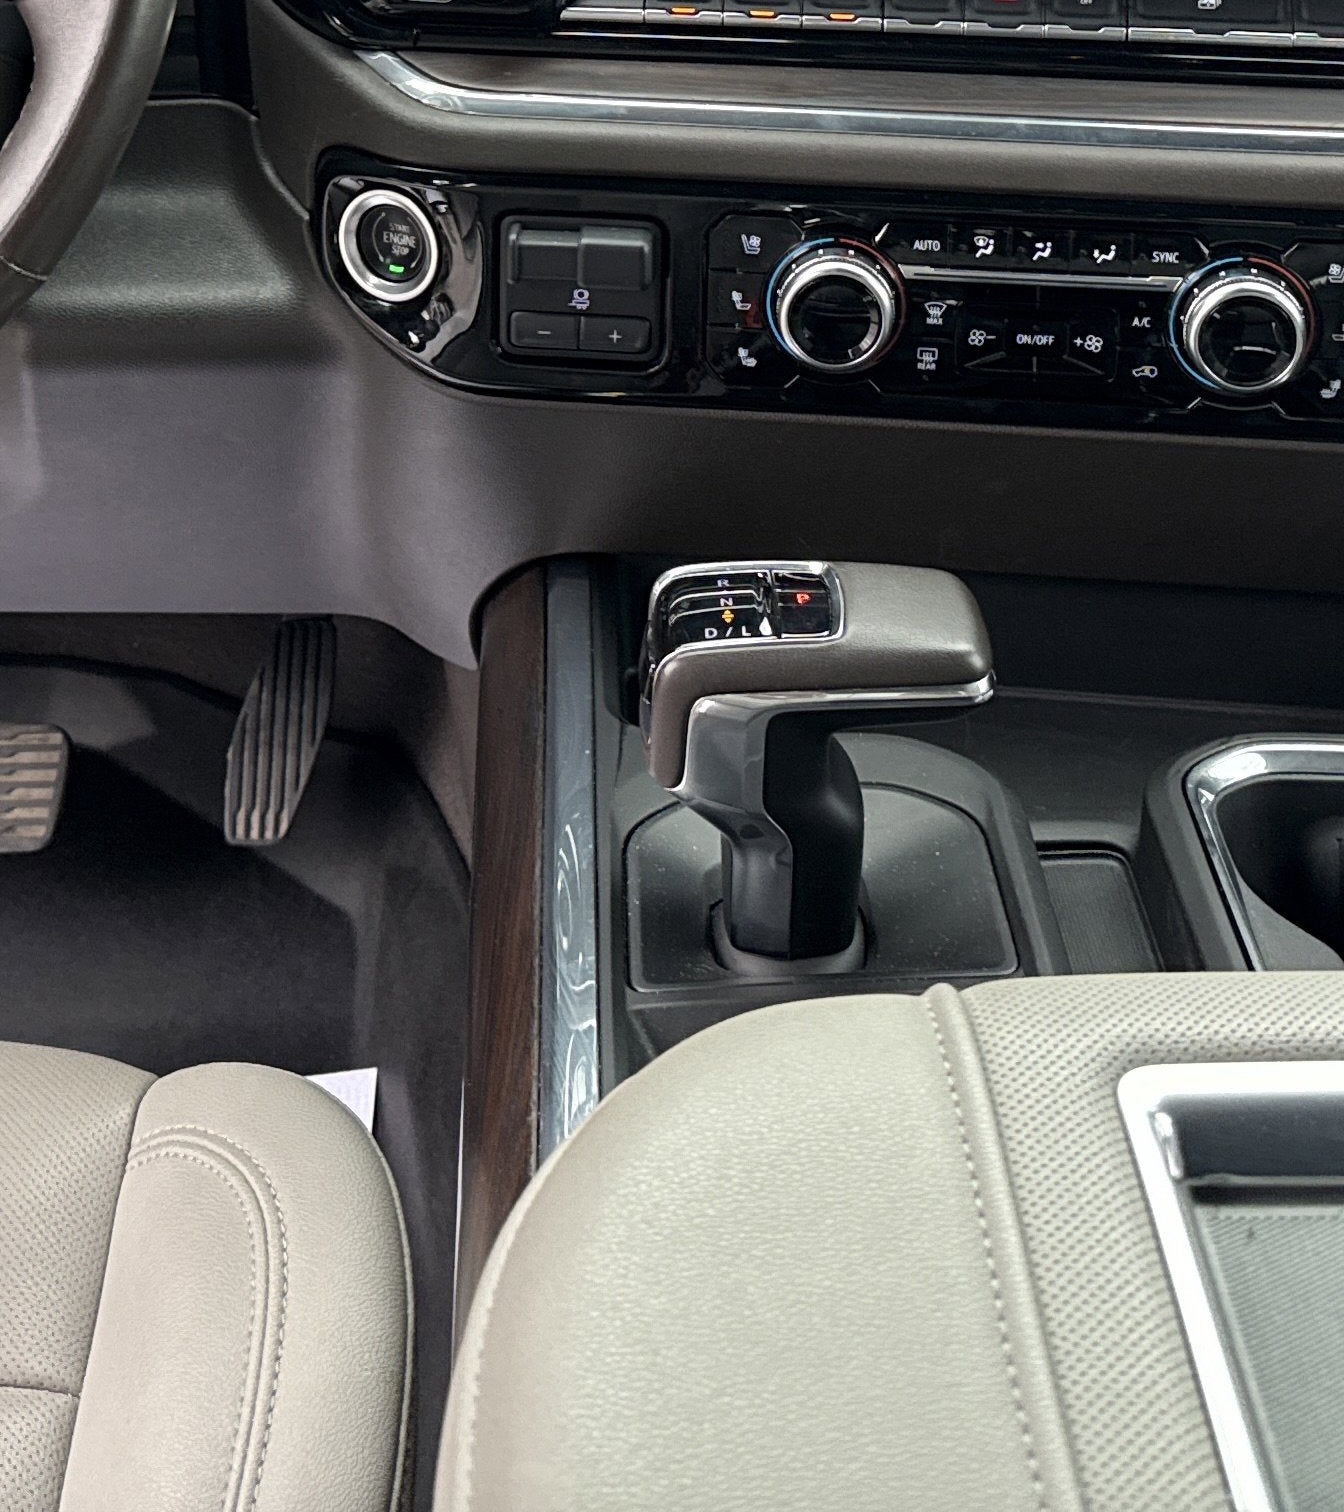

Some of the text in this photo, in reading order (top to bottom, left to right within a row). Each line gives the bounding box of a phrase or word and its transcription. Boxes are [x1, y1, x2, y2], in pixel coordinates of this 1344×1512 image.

[383, 231, 417, 248] ENGINE
[913, 239, 941, 252] AUTO
[1151, 250, 1180, 264] SYNC
[1131, 316, 1152, 329] A/C
[1015, 333, 1056, 347] ON/OFF
[717, 579, 730, 587] R
[719, 597, 733, 607] N
[796, 593, 810, 604] P
[704, 627, 717, 639] D
[741, 625, 751, 637] L
